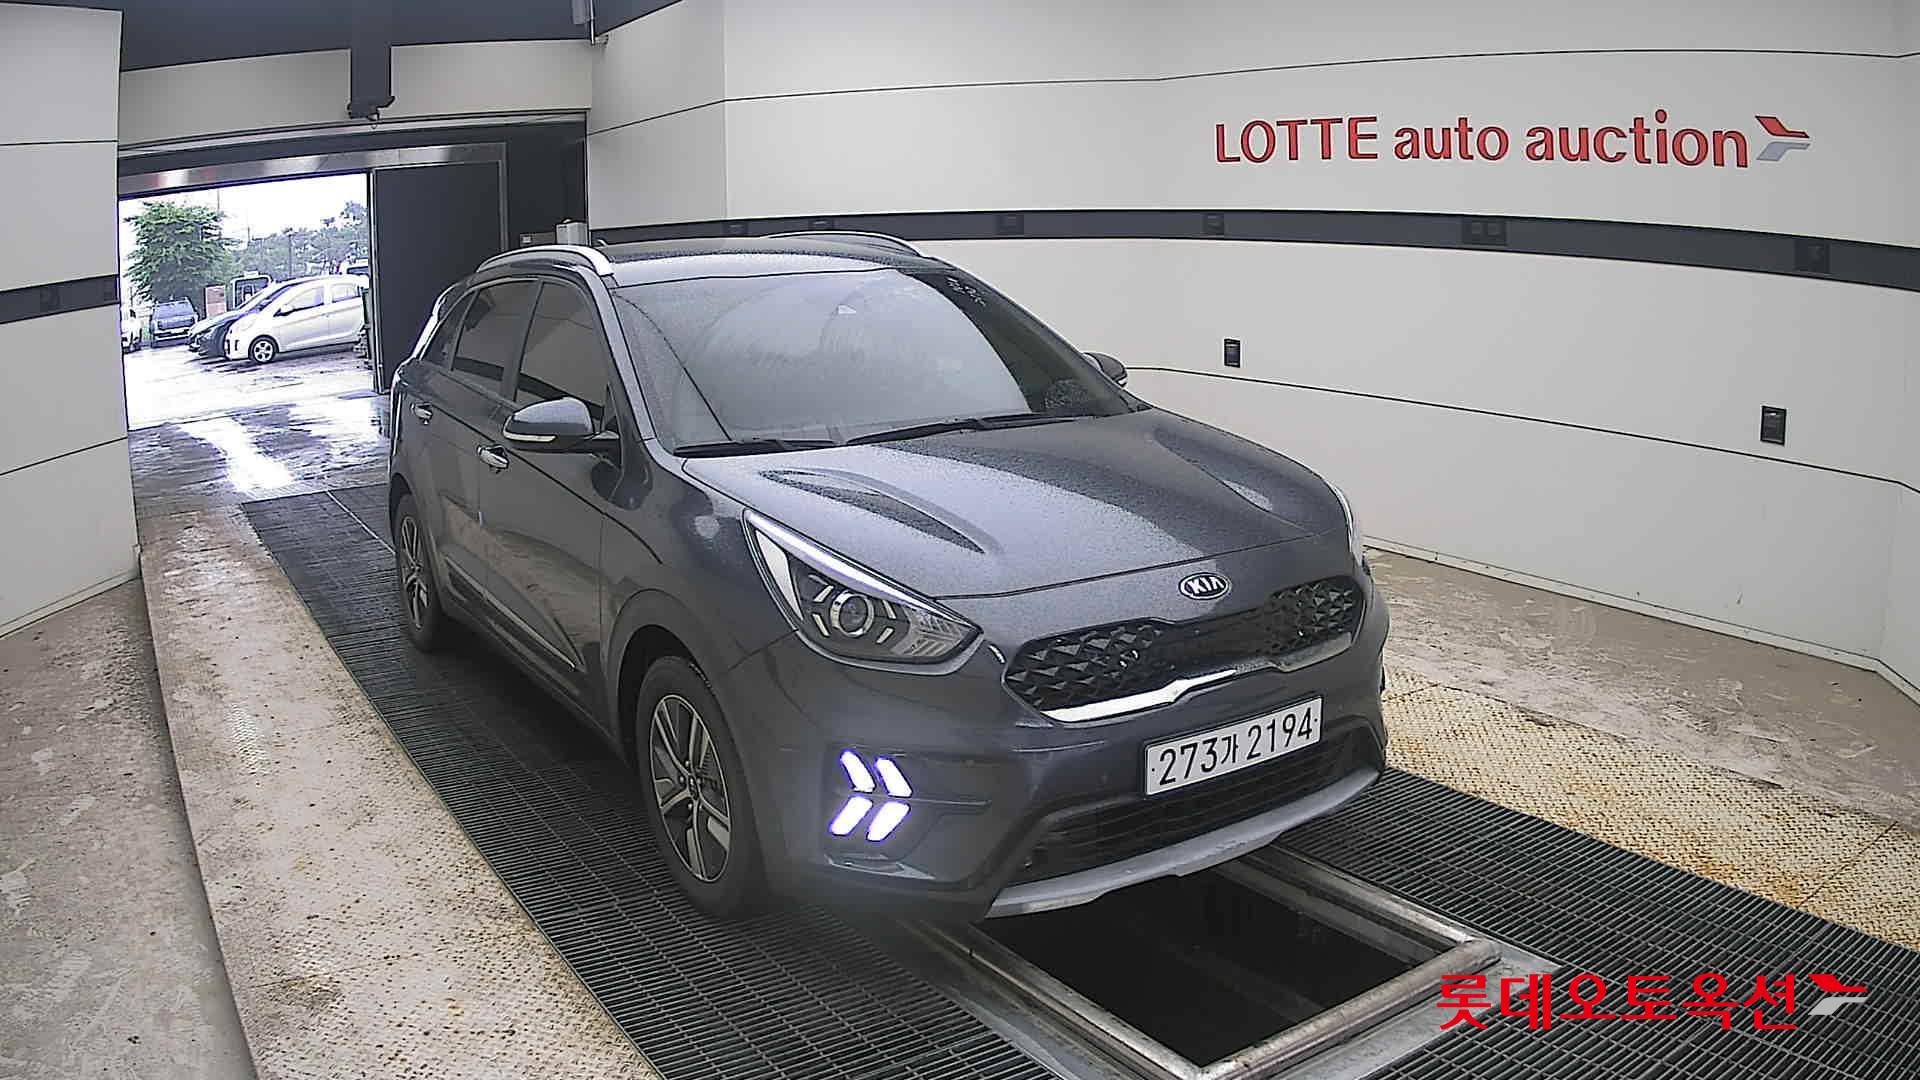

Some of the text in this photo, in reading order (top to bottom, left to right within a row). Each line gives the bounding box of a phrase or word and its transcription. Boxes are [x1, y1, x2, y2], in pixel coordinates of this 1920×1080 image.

[1215, 109, 1750, 169] LOTTE auto auction
[1186, 575, 1225, 595] KIA
[1158, 707, 1313, 786] 273가 2194
